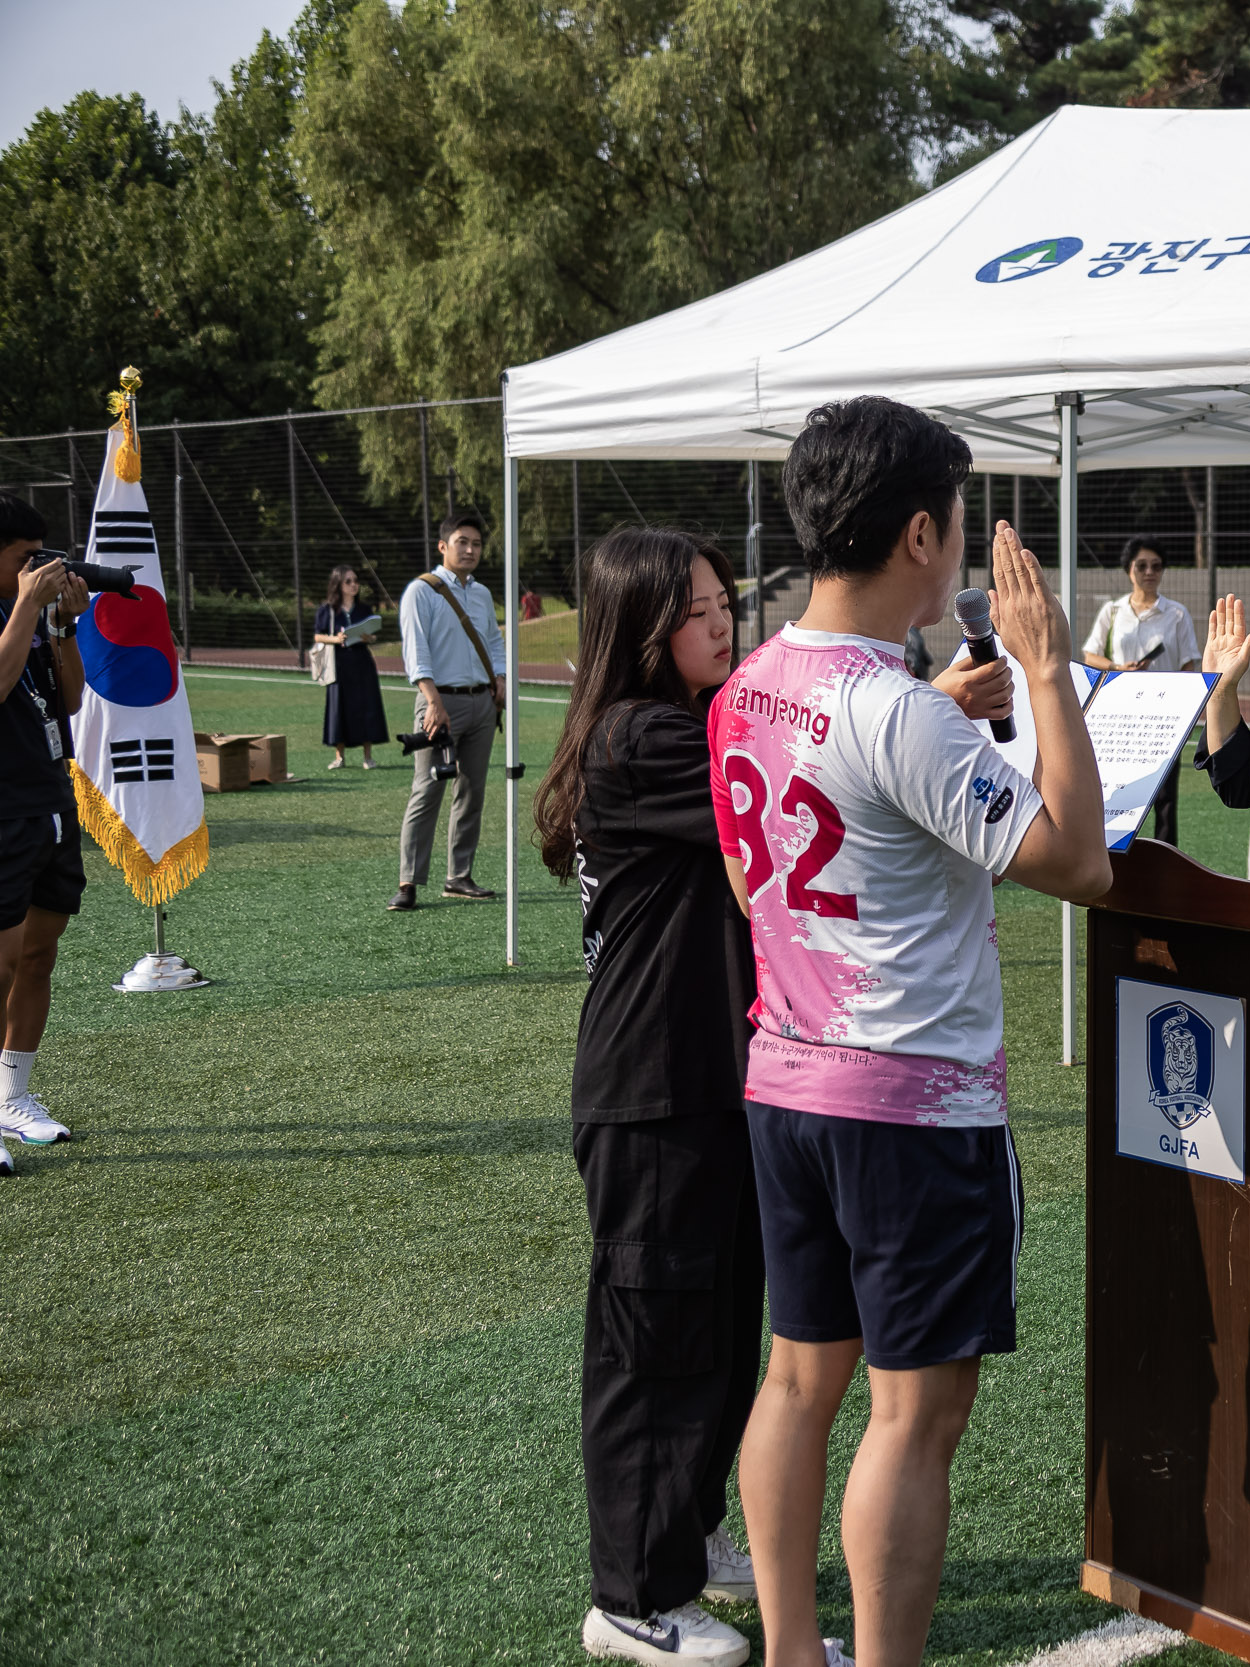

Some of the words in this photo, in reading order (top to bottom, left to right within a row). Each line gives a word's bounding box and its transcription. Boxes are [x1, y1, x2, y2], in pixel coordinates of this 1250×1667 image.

[724, 680, 832, 746] Namjeong
[724, 750, 859, 921] 82
[780, 1044, 815, 1057] 누군가에게
[814, 1048, 837, 1061] 기억이
[1159, 1134, 1200, 1160] GJFA
